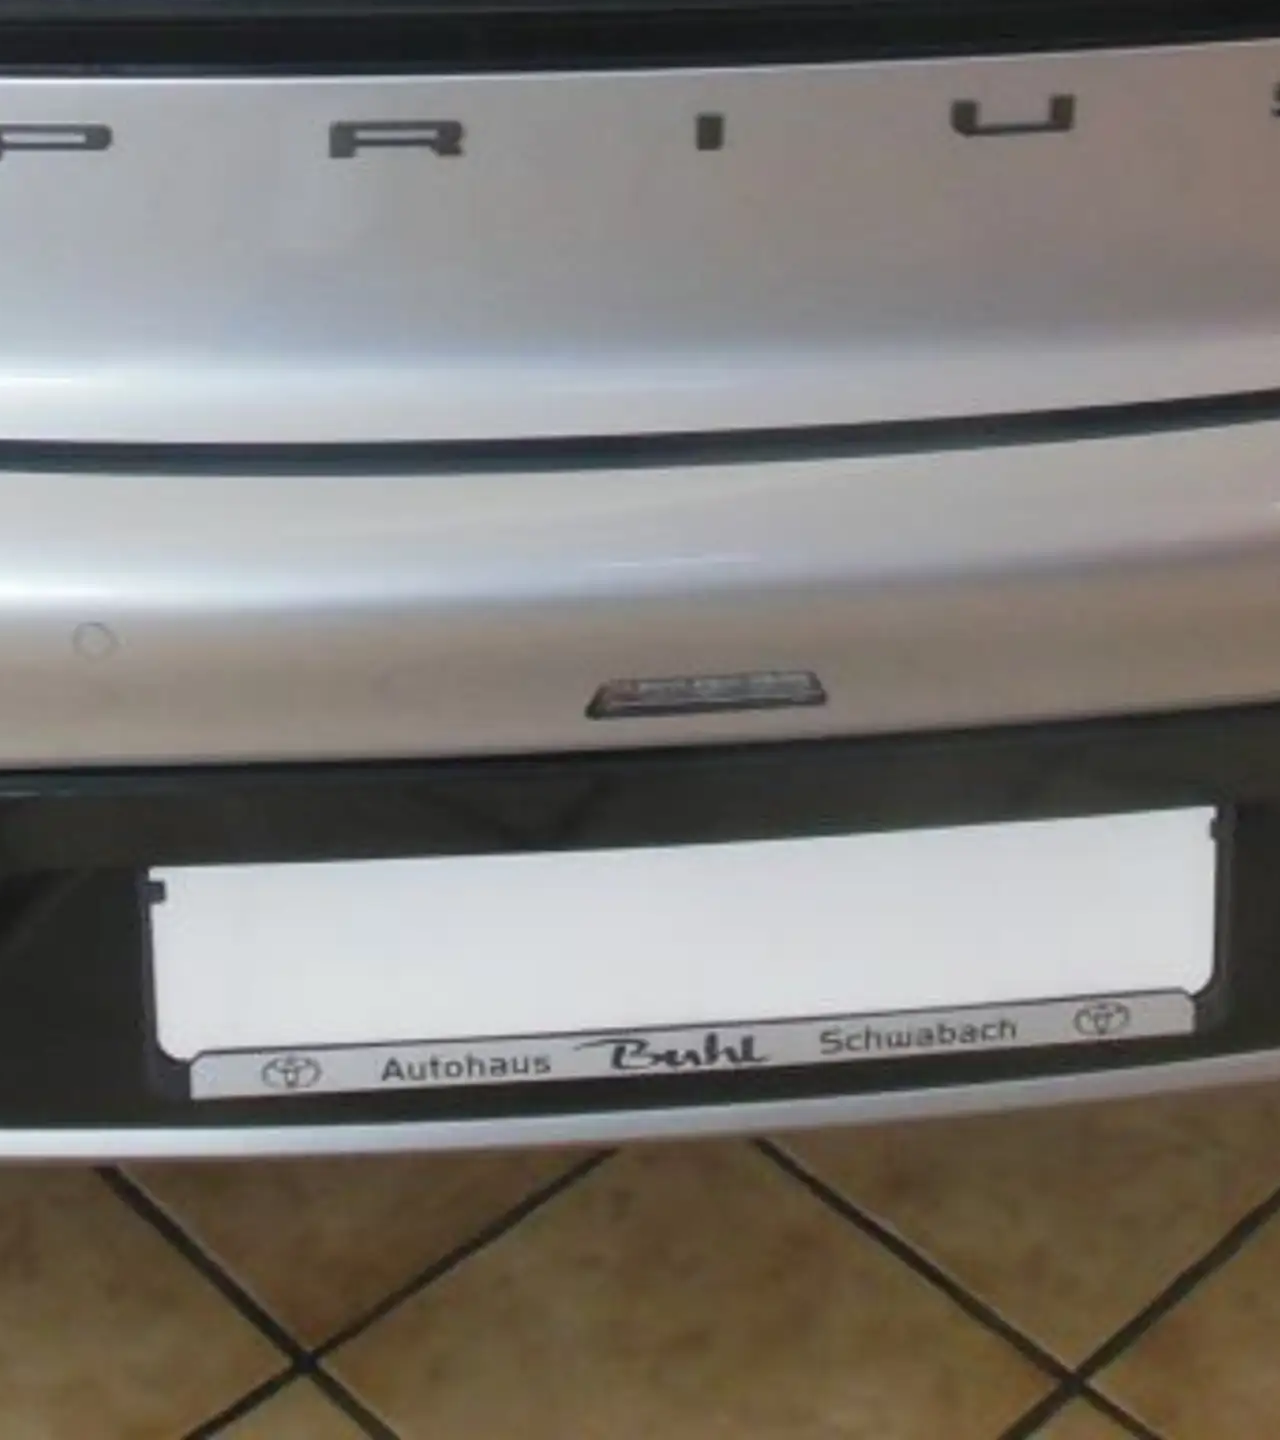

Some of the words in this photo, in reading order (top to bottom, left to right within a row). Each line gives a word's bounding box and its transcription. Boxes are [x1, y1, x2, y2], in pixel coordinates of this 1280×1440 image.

[381, 1048, 552, 1082] Autohaus
[572, 1030, 769, 1071] Buhl
[819, 1017, 1018, 1056] Schwabach
